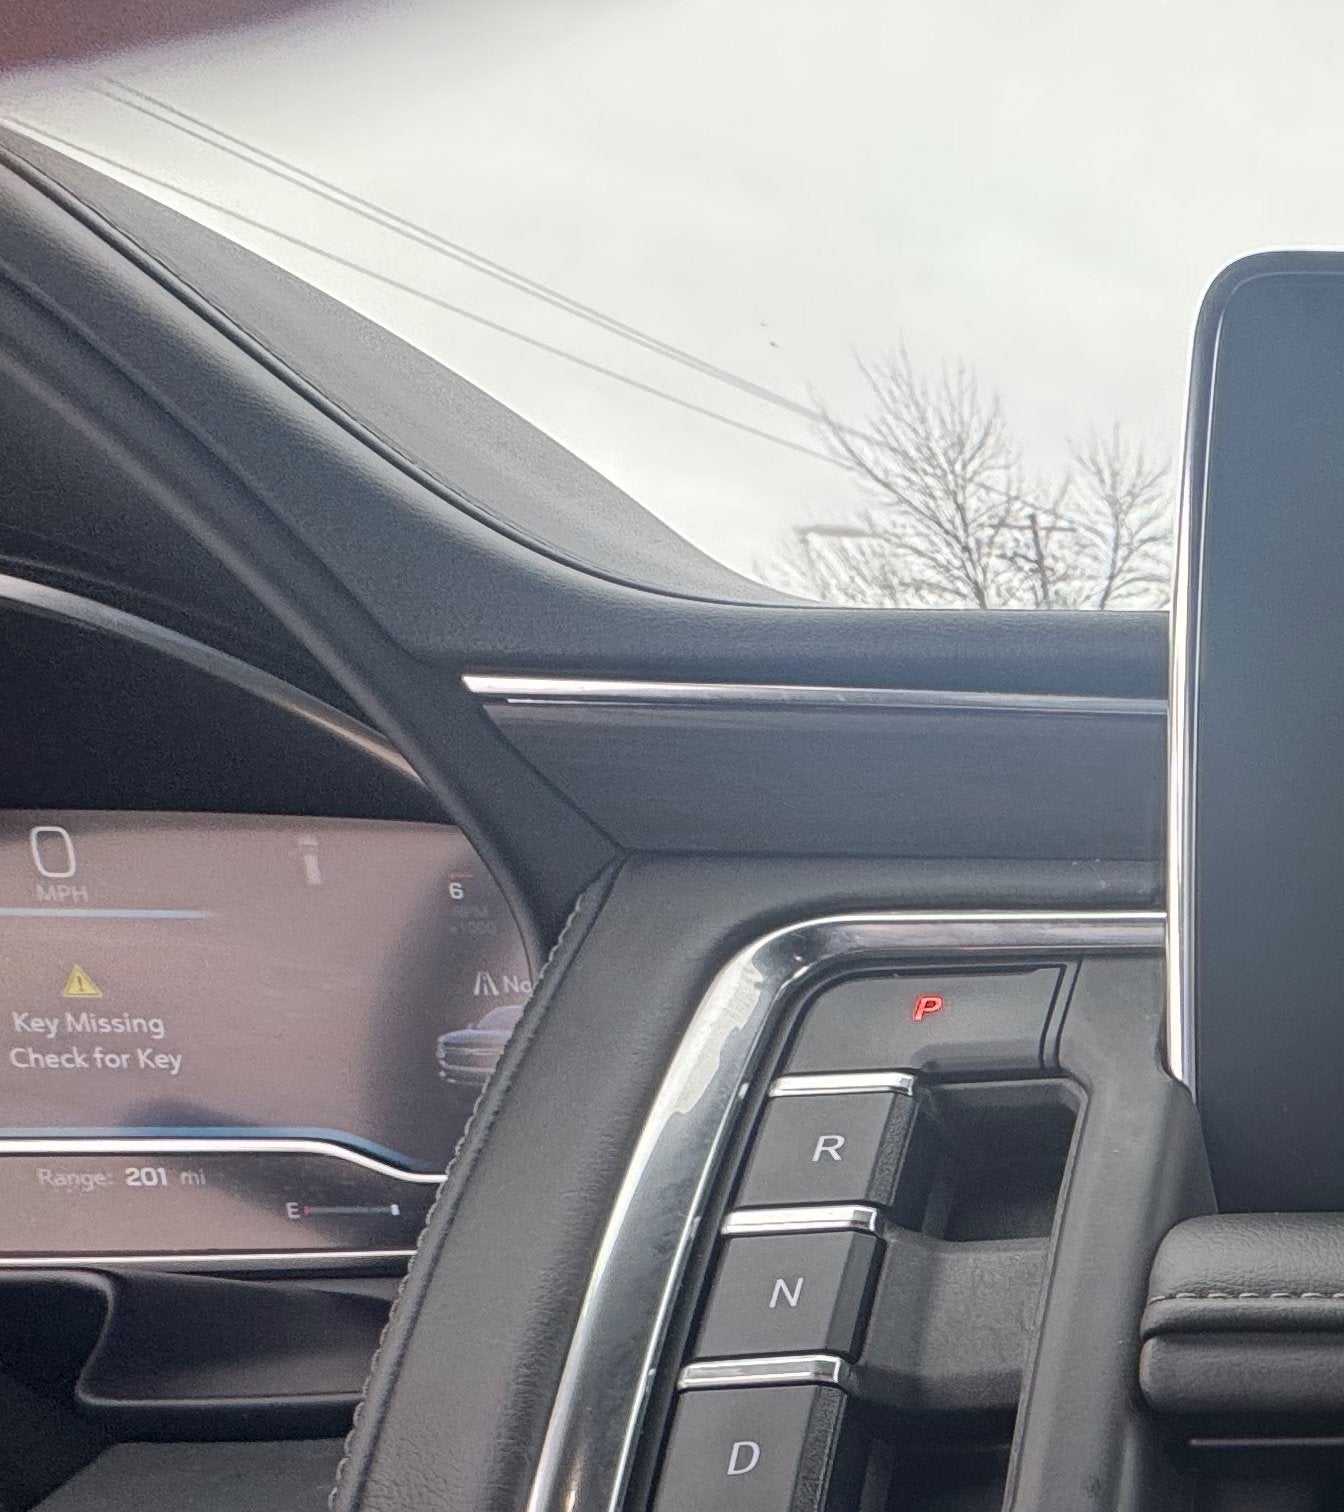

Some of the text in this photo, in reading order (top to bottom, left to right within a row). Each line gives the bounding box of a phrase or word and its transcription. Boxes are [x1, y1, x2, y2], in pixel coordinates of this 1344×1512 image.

[36, 884, 89, 903] MPH
[913, 995, 943, 1021] P
[13, 1012, 166, 1039] Key Missing
[10, 1047, 182, 1075] Check for Key
[812, 1134, 846, 1162] R
[37, 1167, 206, 1193] Range: 201 mi
[286, 1202, 300, 1219] E
[768, 1278, 803, 1308] N
[727, 1441, 760, 1475] D
